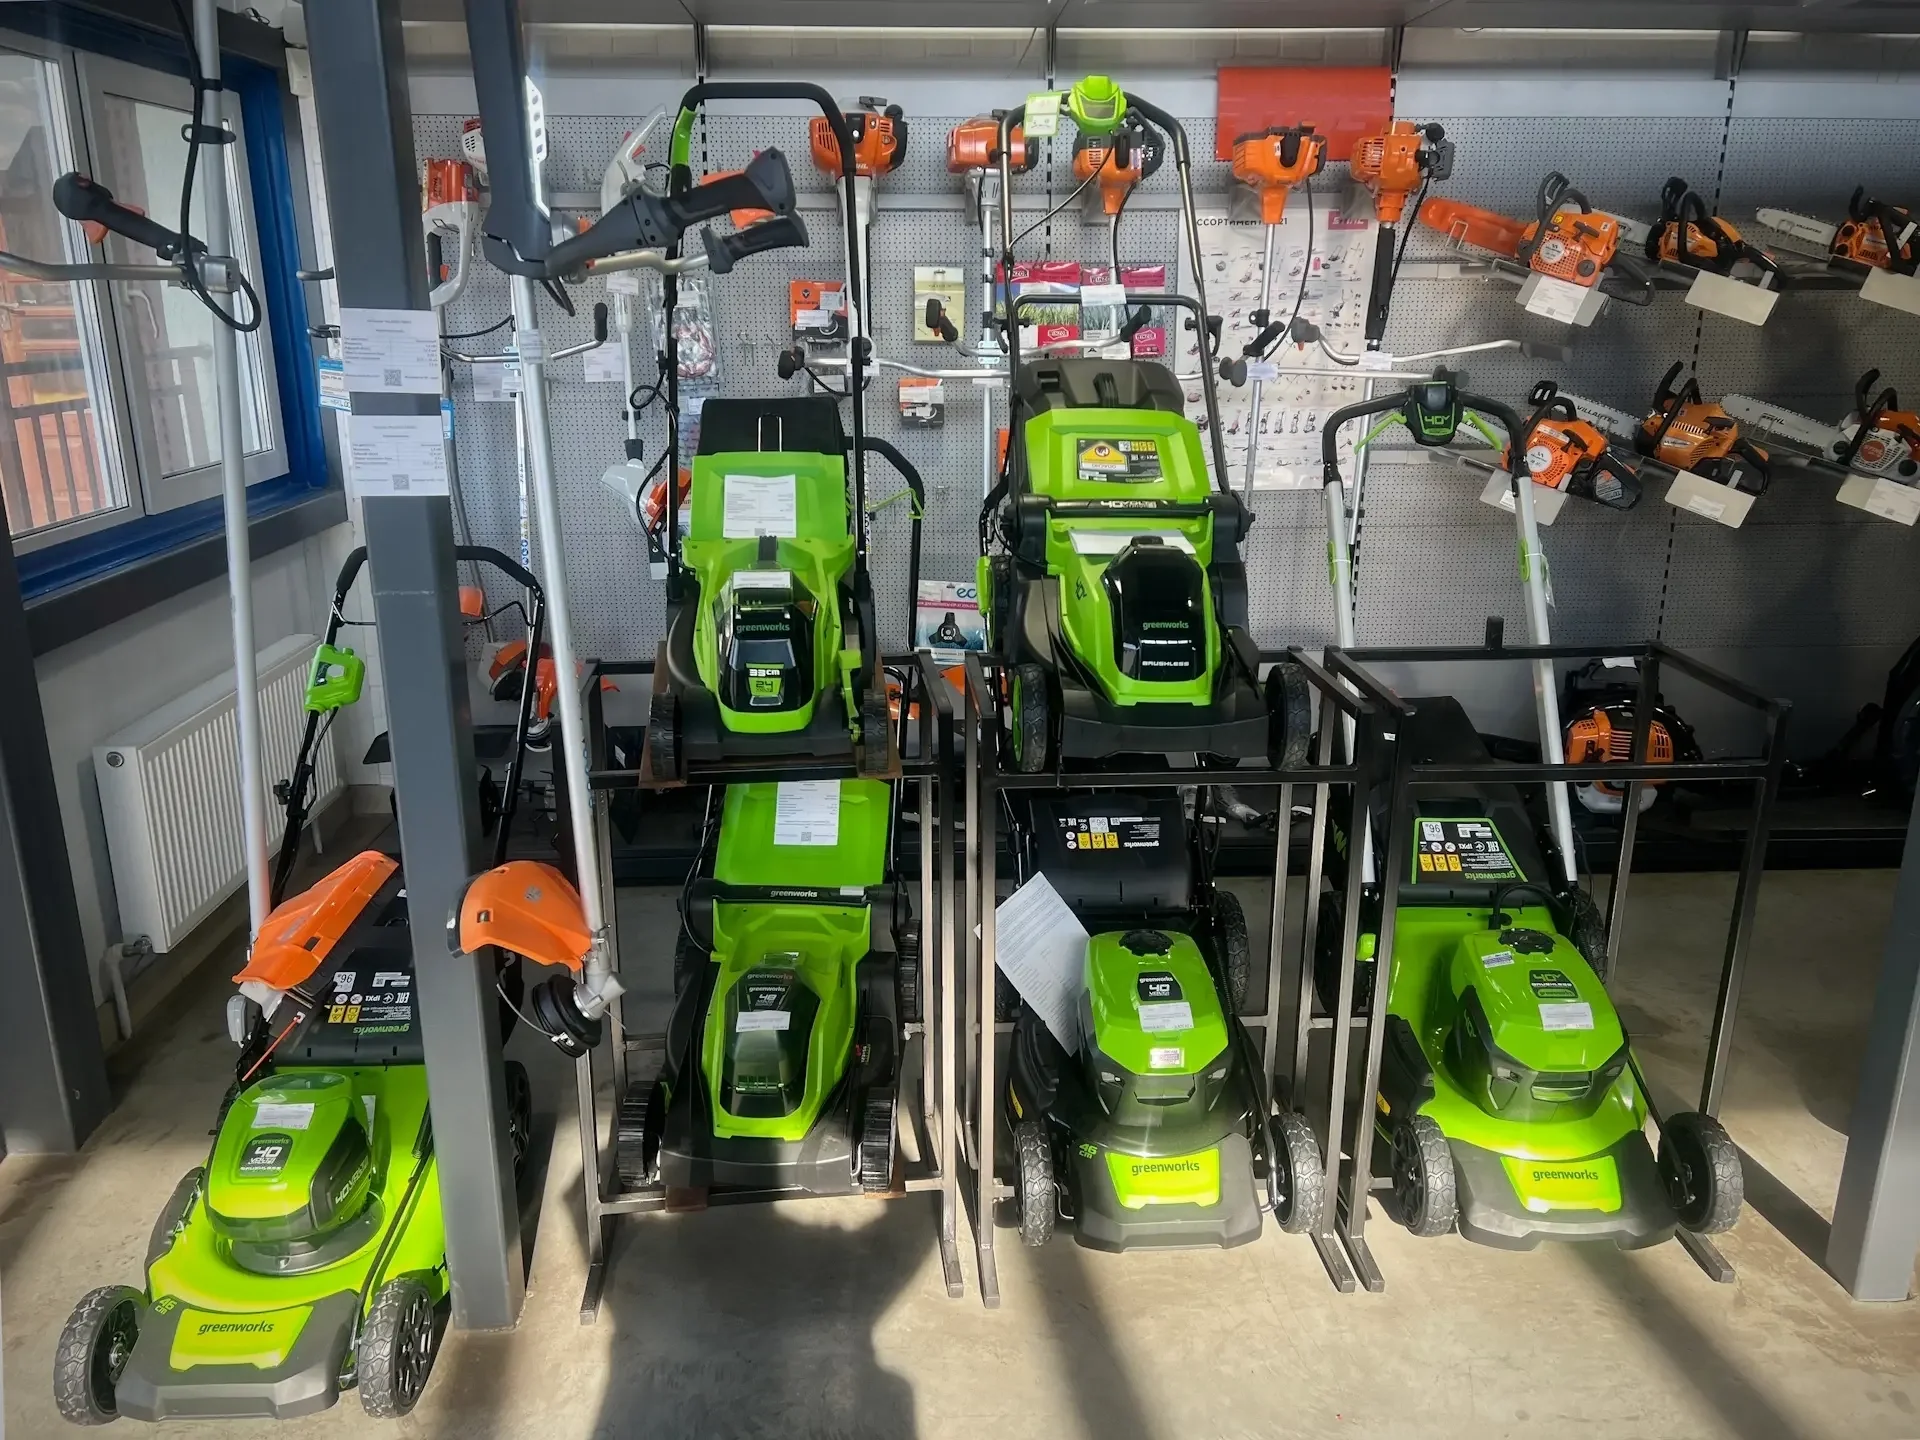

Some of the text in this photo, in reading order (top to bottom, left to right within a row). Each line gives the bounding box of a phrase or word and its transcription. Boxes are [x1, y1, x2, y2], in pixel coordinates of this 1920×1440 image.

[736, 622, 790, 633] greenworks
[1142, 620, 1189, 630] greenworks
[1465, 870, 1516, 880] greenworks
[770, 890, 818, 898] greenworks
[1139, 976, 1174, 984] greenworks
[1149, 983, 1170, 992] 40
[352, 1023, 410, 1036] greenworks
[254, 1146, 283, 1158] 40
[1079, 1143, 1098, 1155] 46
[1079, 1150, 1093, 1159] cm
[1131, 1160, 1200, 1176] greenworks
[1533, 1169, 1599, 1181] greenworks
[160, 1298, 178, 1310] 46
[155, 1305, 168, 1315] cm
[197, 1320, 274, 1335] greenworks
